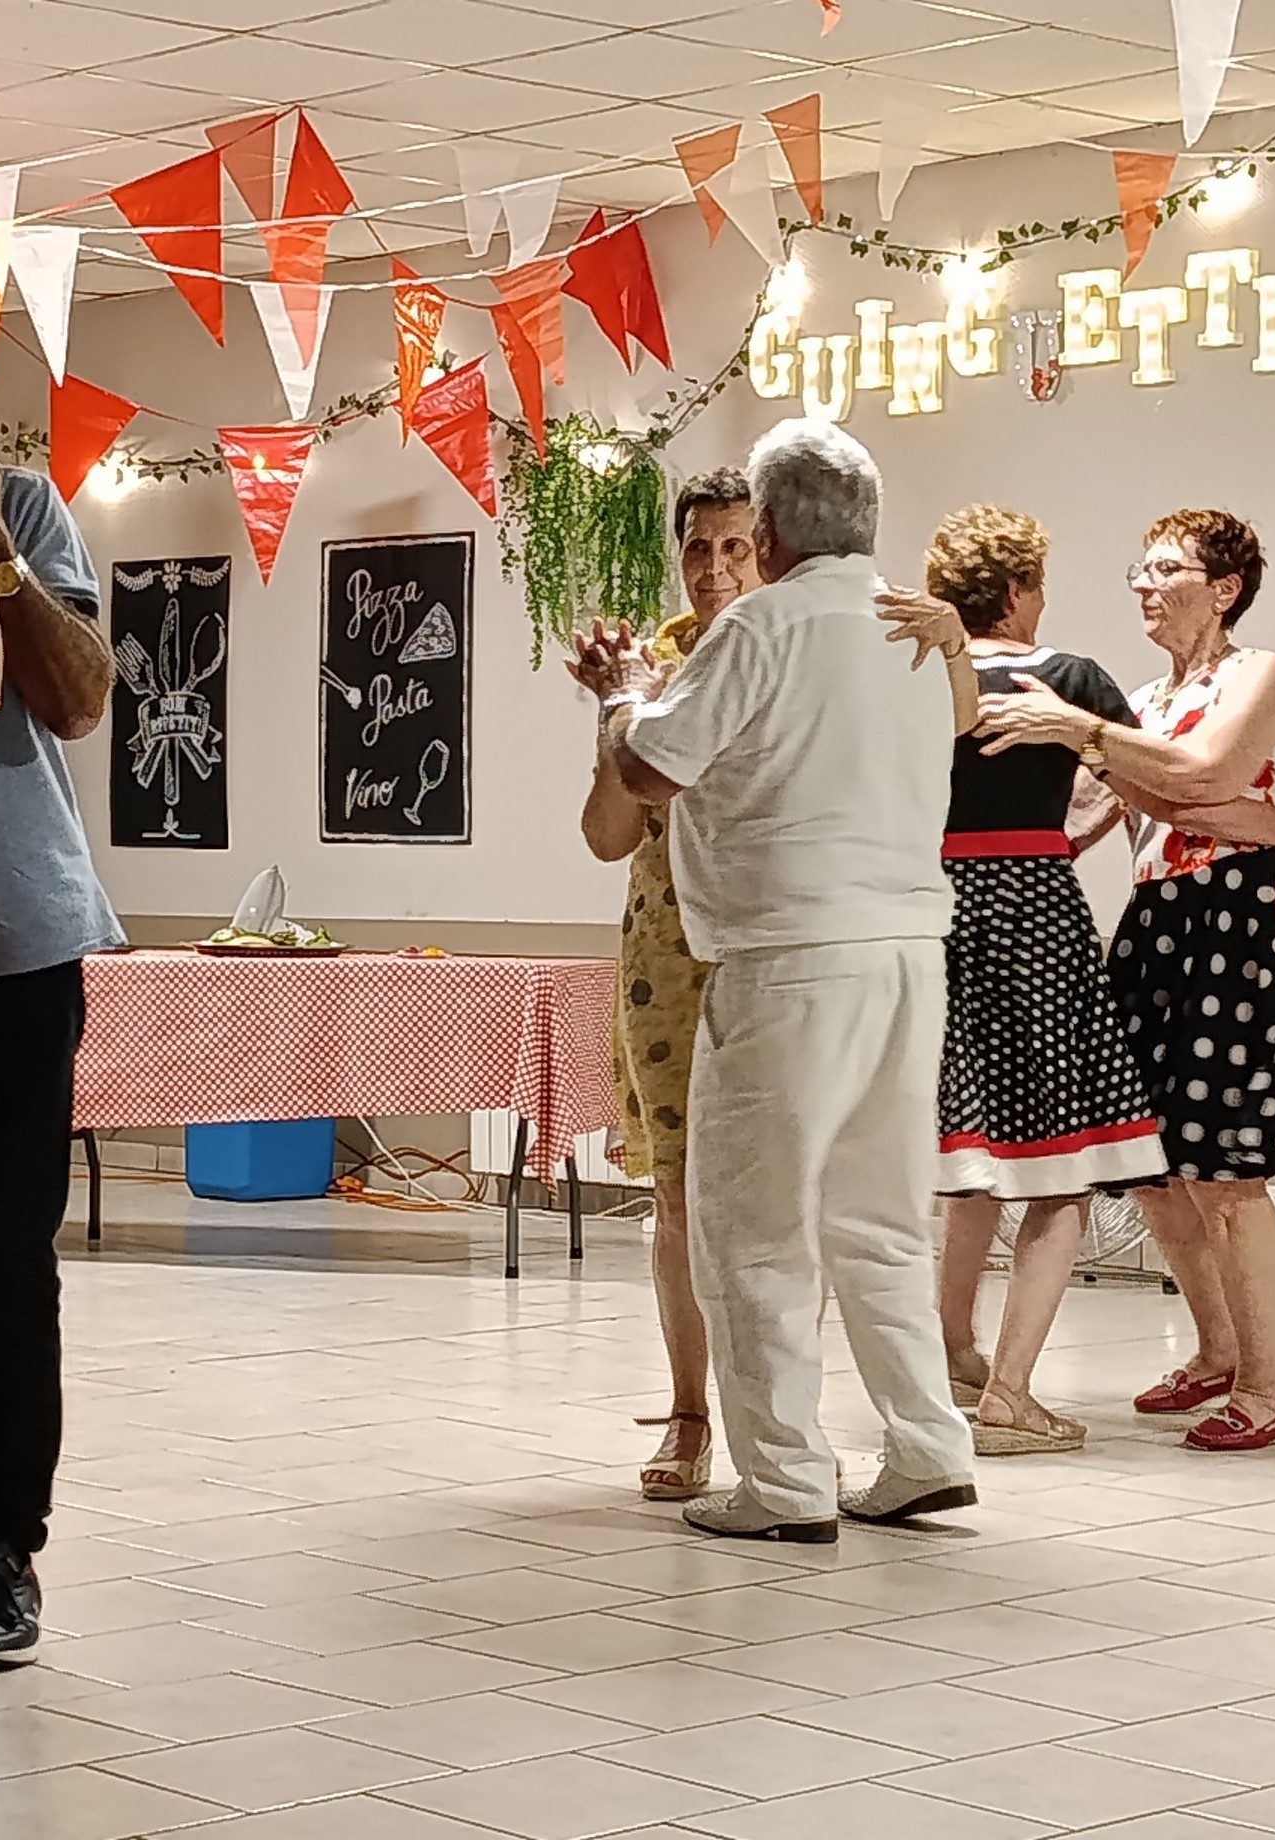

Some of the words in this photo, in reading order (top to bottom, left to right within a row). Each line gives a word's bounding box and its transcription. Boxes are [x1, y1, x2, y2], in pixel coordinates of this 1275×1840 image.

[346, 568, 423, 656] Pizza
[361, 673, 433, 746] Pasta
[345, 768, 399, 819] Vino
